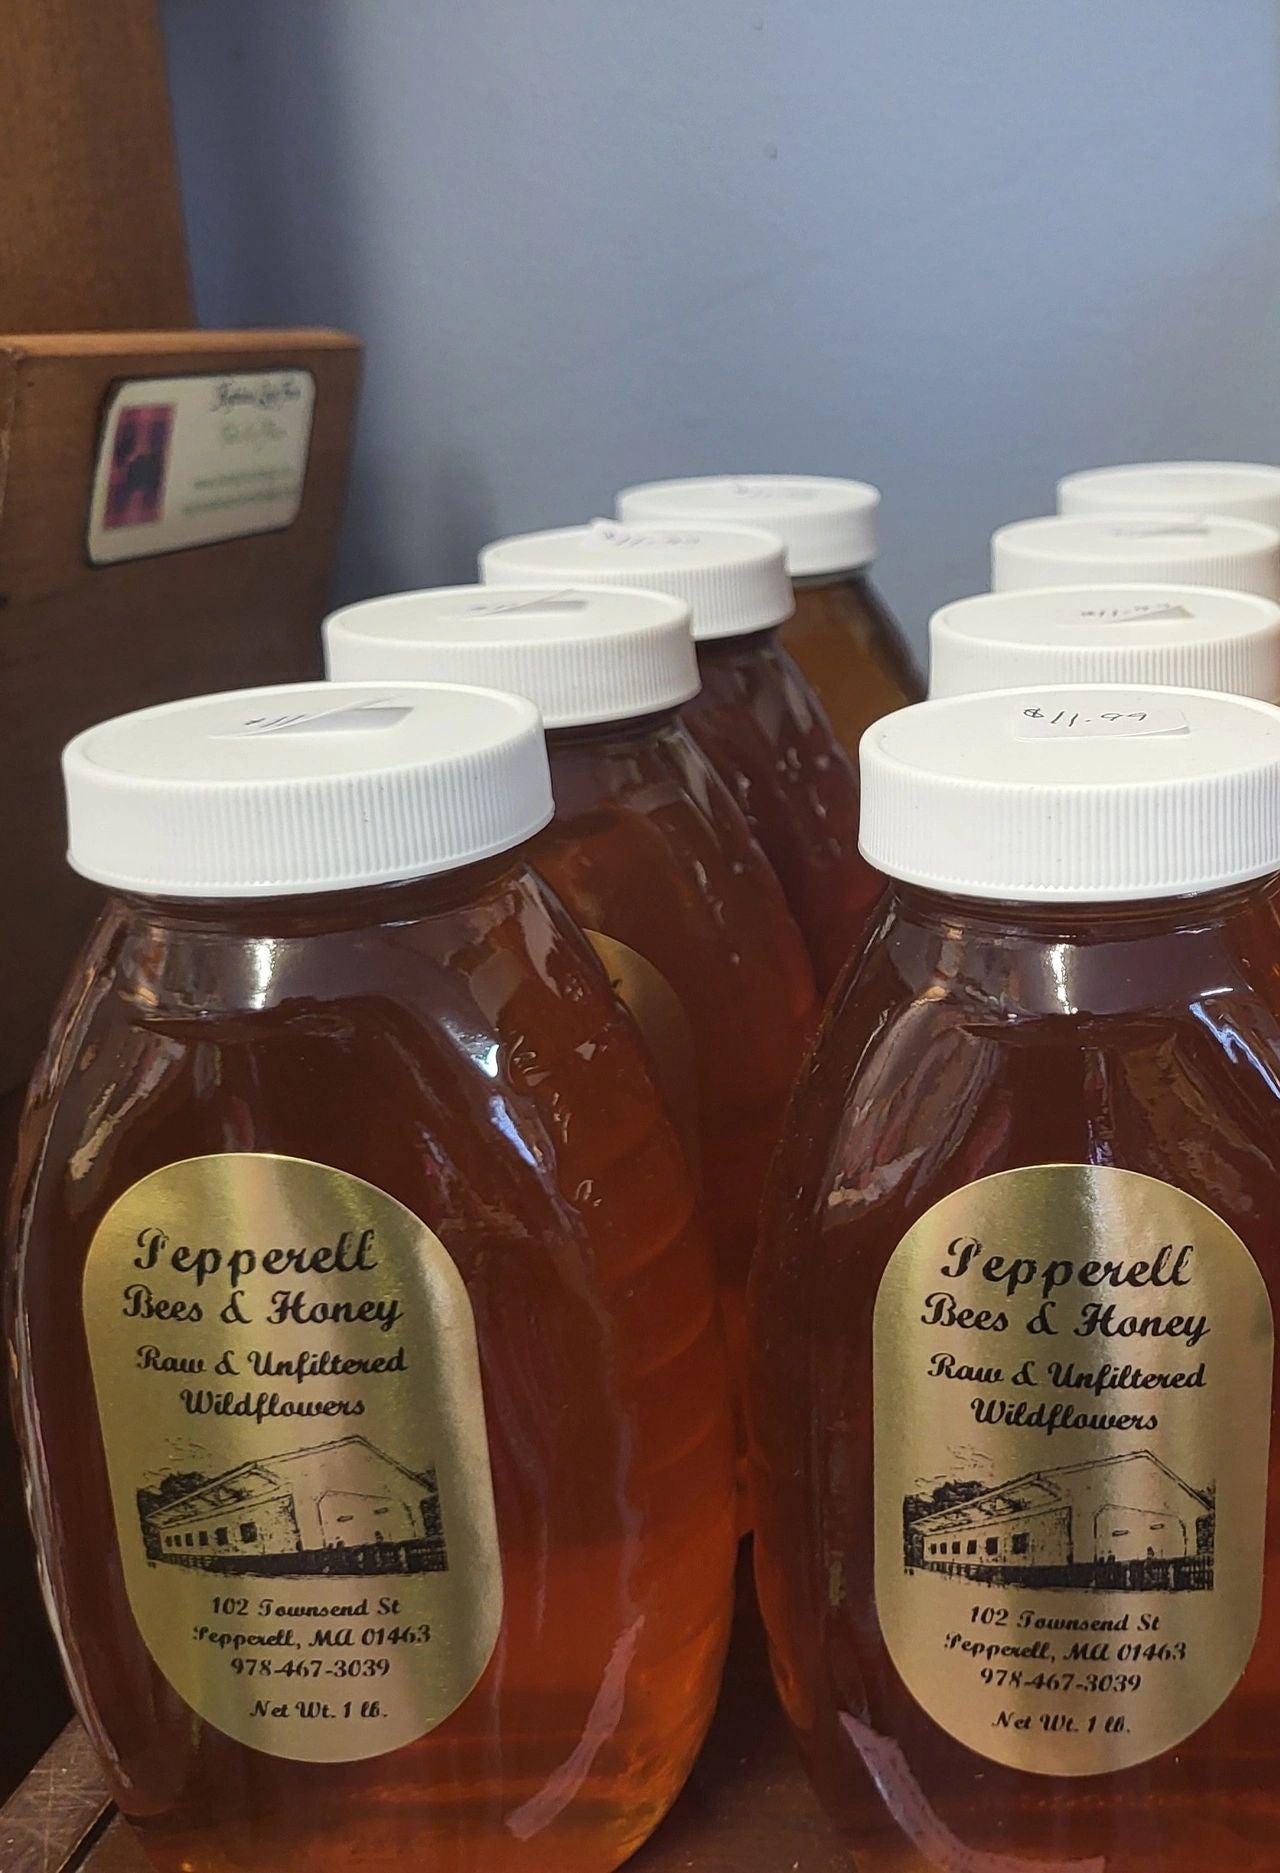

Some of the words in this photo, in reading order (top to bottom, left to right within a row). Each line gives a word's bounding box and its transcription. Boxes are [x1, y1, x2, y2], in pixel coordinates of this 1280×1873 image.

[1023, 707, 1147, 727] $11.99
[134, 1227, 379, 1287] Pepperell
[940, 1236, 1194, 1298] Pepperell
[123, 1284, 203, 1323] Bees
[220, 1290, 251, 1325] &
[266, 1291, 403, 1331] Honey
[921, 1291, 1009, 1331] Bees
[1026, 1301, 1057, 1335] &
[1073, 1302, 1211, 1347] Honey
[136, 1344, 206, 1372] Raw
[214, 1349, 240, 1376] &
[247, 1346, 408, 1383] Unfiltered
[927, 1352, 1005, 1383] Raw
[1012, 1361, 1038, 1386] &
[1047, 1362, 1207, 1395] Unfiltered
[179, 1388, 366, 1424] Wildflowers
[970, 1398, 1159, 1435] Wildflowers
[211, 1596, 249, 1616] 102
[258, 1598, 369, 1617] Townsend
[377, 1597, 402, 1616] St
[970, 1606, 1009, 1627] 102
[1016, 1610, 1129, 1631] Townsend
[1137, 1613, 1161, 1631] St
[193, 1625, 301, 1650] Pepperell,
[309, 1628, 355, 1647] MA
[362, 1624, 431, 1645] 01463
[944, 1632, 1056, 1664] Pepperell,
[1063, 1643, 1110, 1661] MA
[1116, 1642, 1187, 1661] 01463
[231, 1658, 390, 1678] 978-467-3039
[980, 1668, 1142, 1692] 978-467-3039
[250, 1701, 290, 1718] Net
[297, 1702, 335, 1718] Wt.
[343, 1702, 351, 1718] 1
[360, 1701, 387, 1718] lb.
[992, 1710, 1032, 1730] Net
[1039, 1714, 1079, 1732] Wt.
[1087, 1715, 1096, 1732] 1
